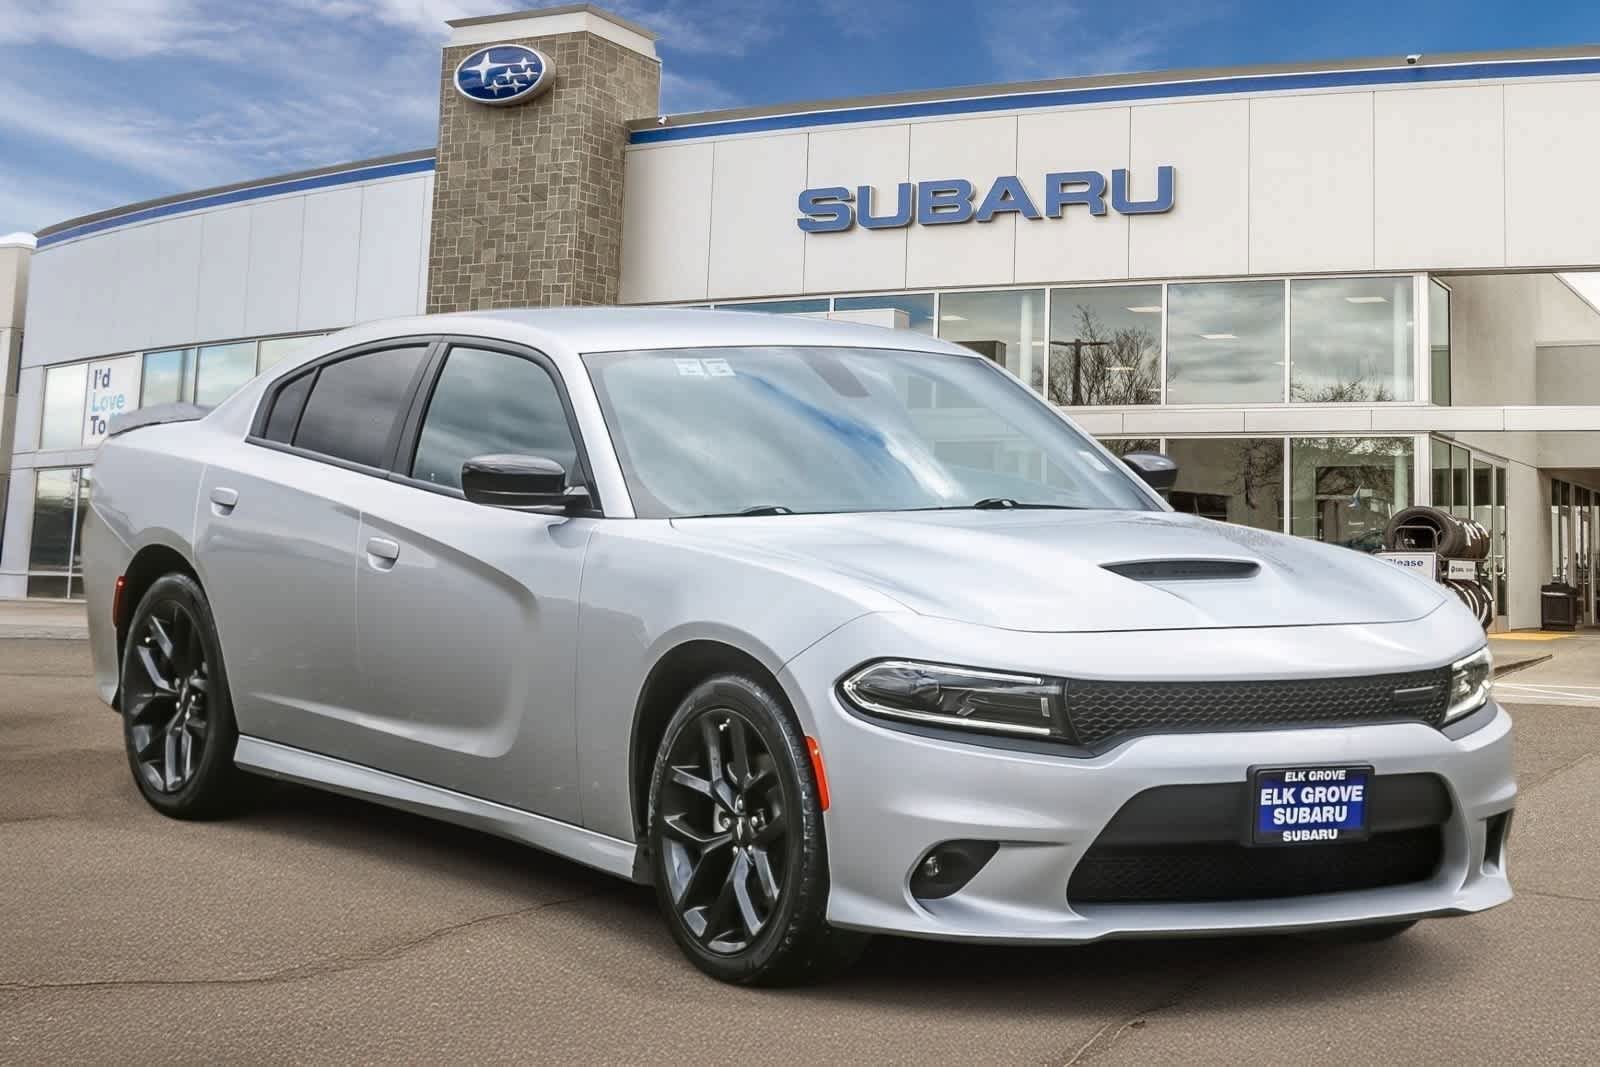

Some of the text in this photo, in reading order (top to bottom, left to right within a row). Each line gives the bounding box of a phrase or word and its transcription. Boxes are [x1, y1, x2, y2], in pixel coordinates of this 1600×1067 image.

[796, 165, 1177, 233] SUBARU
[94, 368, 111, 389] I'd
[91, 392, 125, 412] Love
[90, 416, 106, 435] To
[1284, 770, 1346, 782] ELK GROVE
[1260, 785, 1363, 806] ELK GROVE
[1273, 806, 1348, 825] SUBARU
[1282, 829, 1338, 842] SUBARU
